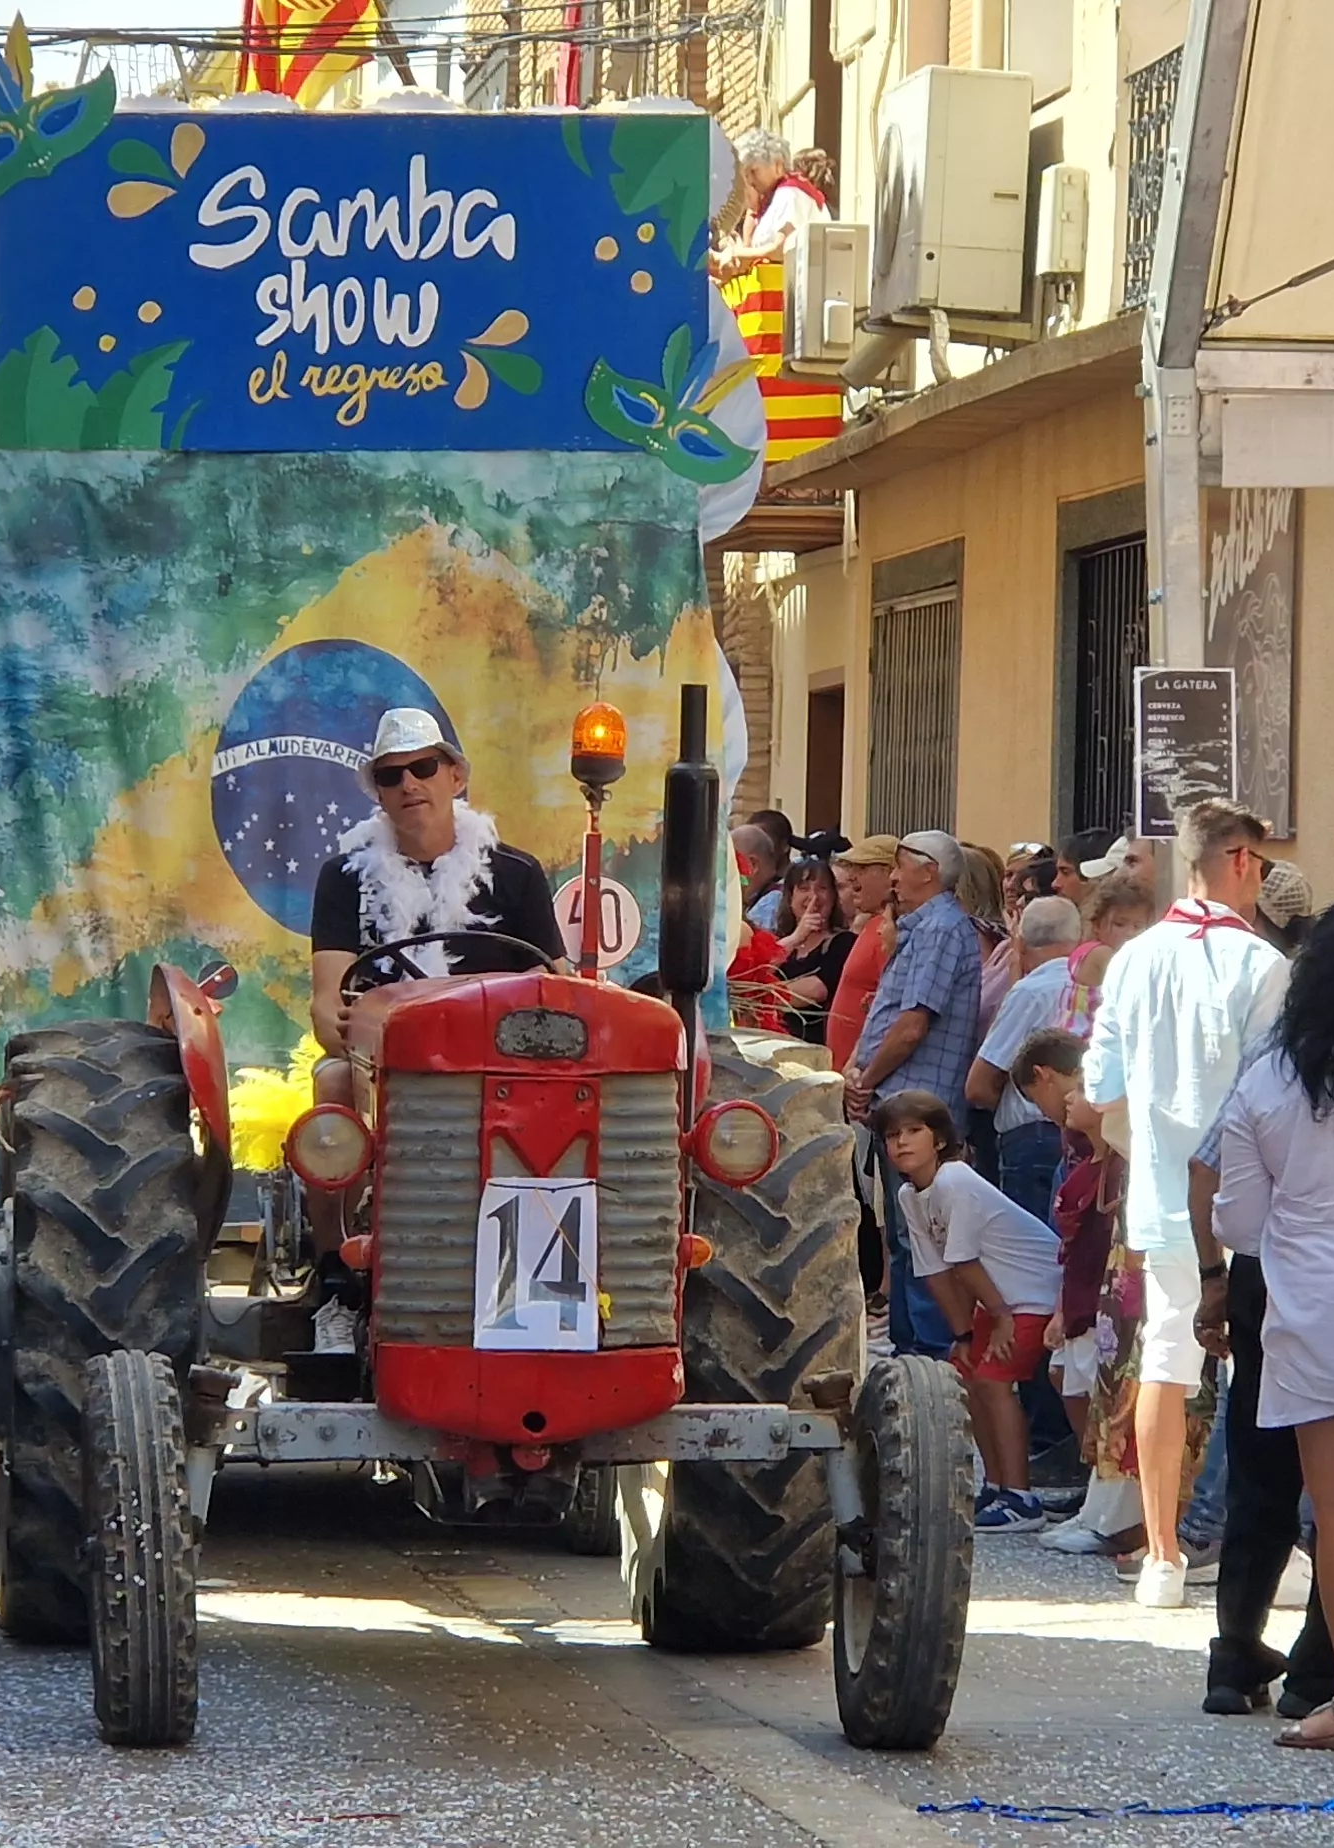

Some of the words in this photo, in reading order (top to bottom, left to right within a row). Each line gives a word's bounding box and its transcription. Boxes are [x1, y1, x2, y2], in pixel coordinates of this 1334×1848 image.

[189, 154, 516, 270] Samba
[255, 260, 440, 354] show
[249, 350, 291, 405] el
[299, 359, 450, 427] regreso
[1155, 680, 1170, 690] LA
[1173, 680, 1217, 690] GATERA
[482, 1195, 587, 1332] 14
